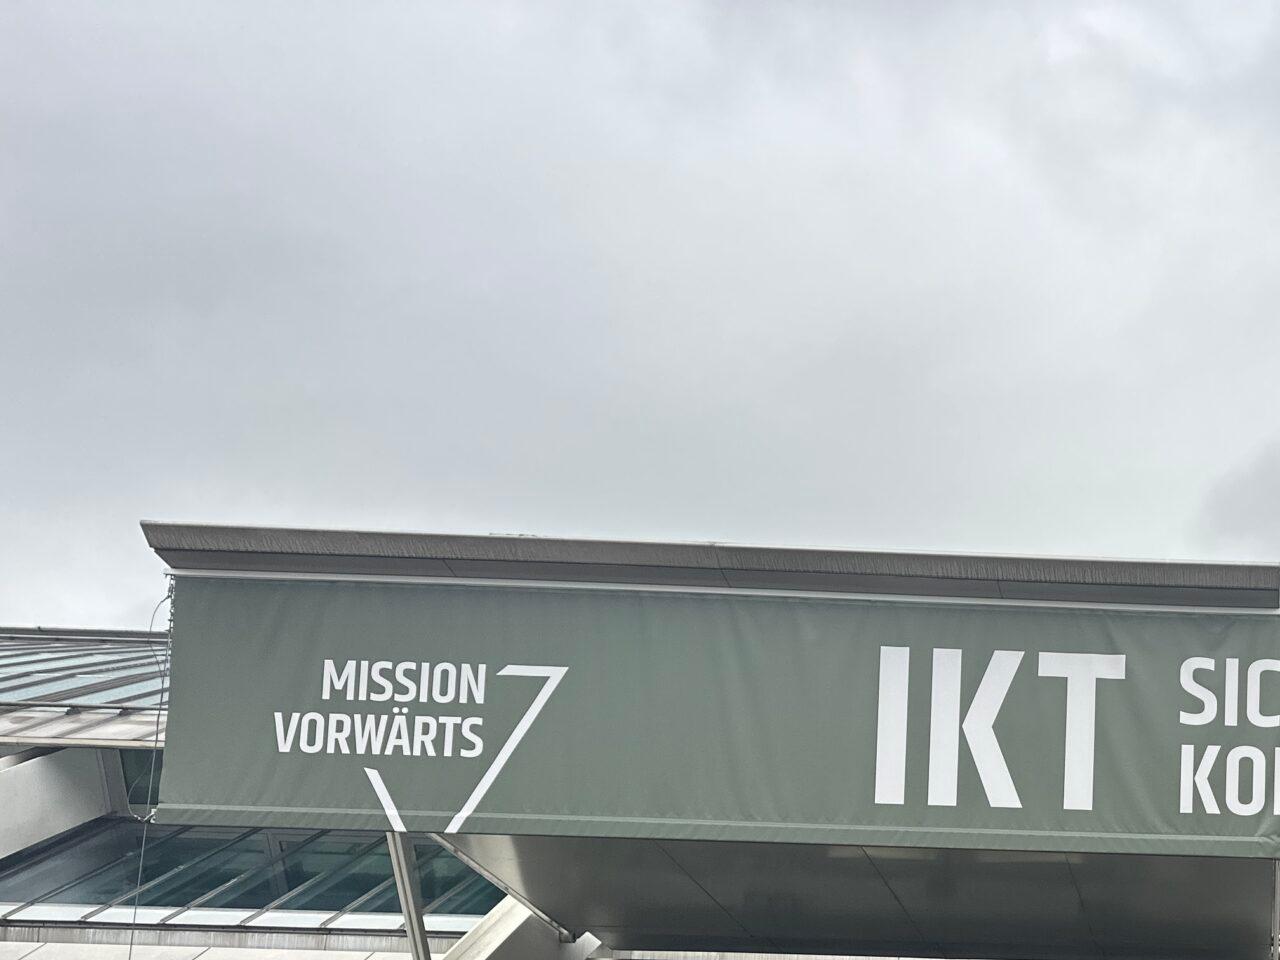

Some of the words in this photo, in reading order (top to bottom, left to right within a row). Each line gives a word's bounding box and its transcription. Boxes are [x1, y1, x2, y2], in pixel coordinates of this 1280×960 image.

[321, 659, 486, 704] MISSION
[273, 706, 484, 758] VORWÄRTS
[875, 645, 1127, 811] IKT
